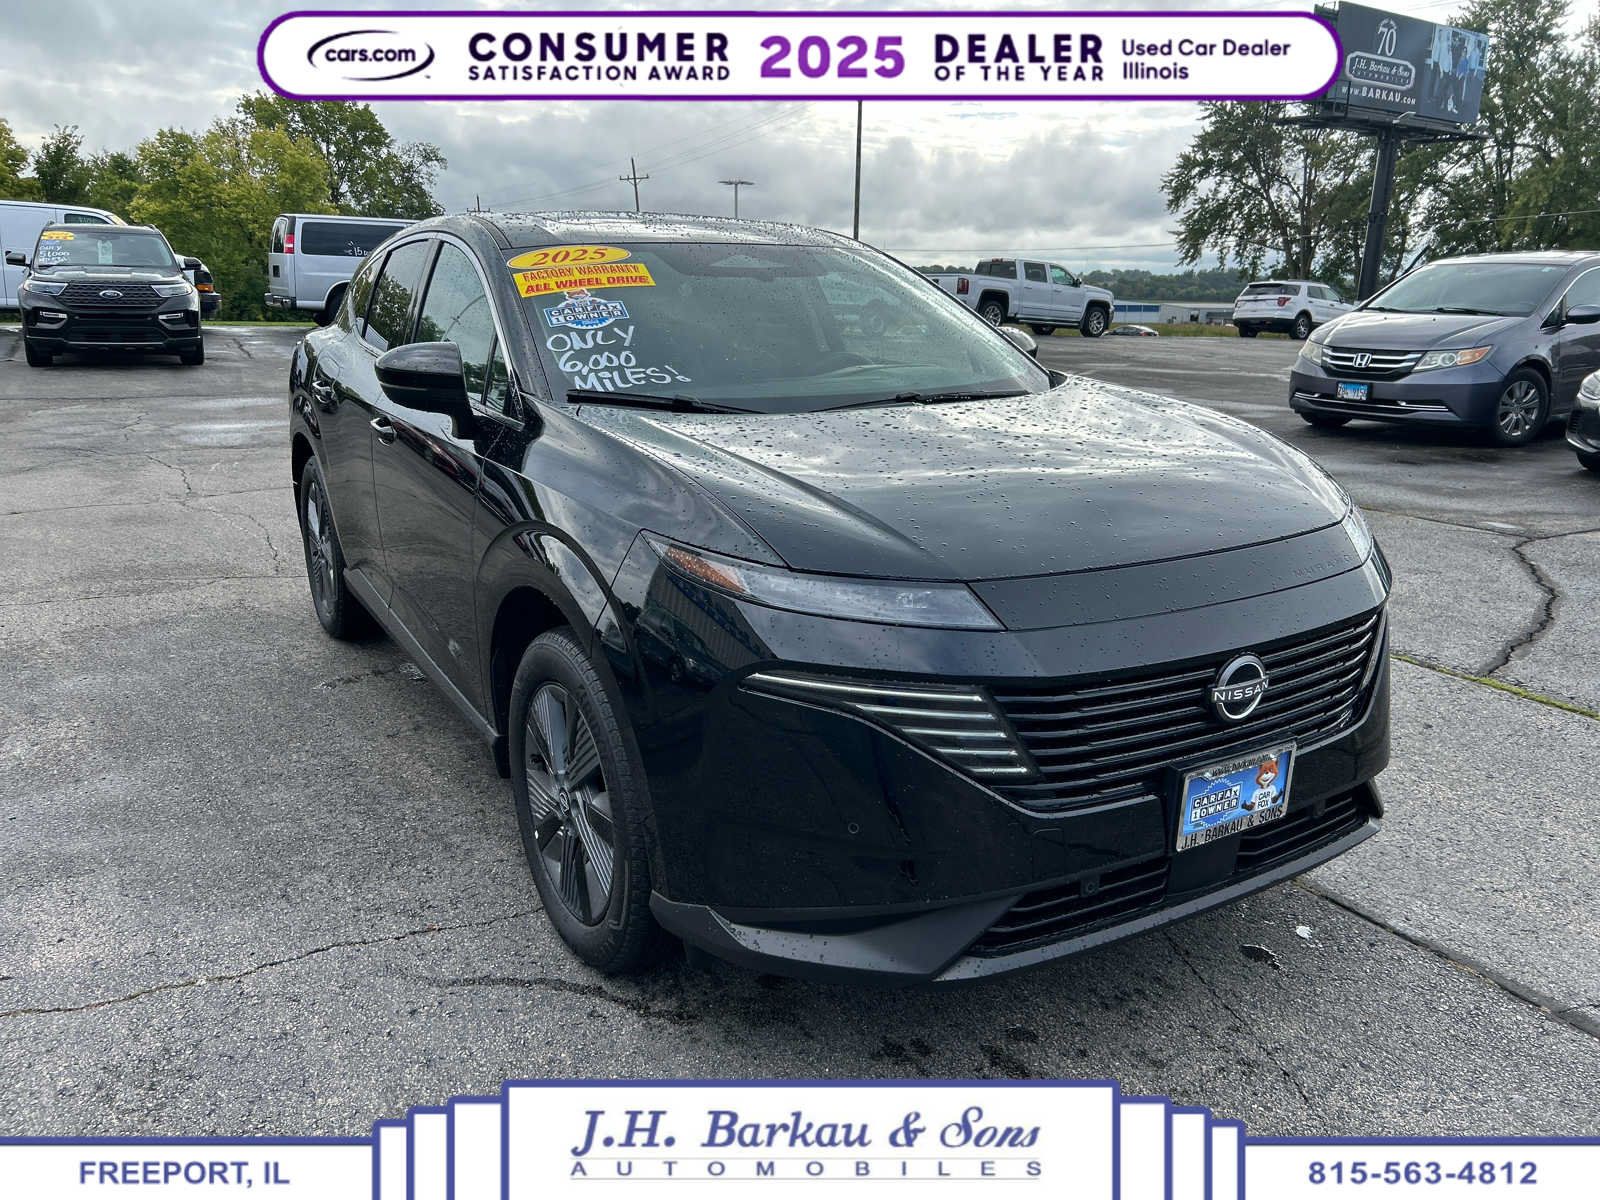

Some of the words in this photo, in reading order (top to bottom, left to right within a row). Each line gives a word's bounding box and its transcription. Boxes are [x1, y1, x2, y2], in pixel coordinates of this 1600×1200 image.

[1377, 27, 1397, 57] 70
[531, 248, 608, 266] 2025
[523, 267, 575, 282] FACTORY
[575, 264, 640, 276] WARRANTY
[525, 284, 554, 295] ALL
[555, 278, 606, 289] WHEEL
[606, 275, 650, 285] DRIVE
[551, 303, 619, 316] CARFAX
[566, 310, 622, 321] OWNER
[546, 325, 635, 351] ONLY
[558, 350, 637, 375] 6,000
[1214, 678, 1270, 701] NISSAN
[1194, 787, 1239, 808] CARFAX
[1257, 800, 1270, 809] FOX
[1258, 790, 1271, 800] CAR
[1201, 800, 1238, 818] OWNER
[1205, 817, 1243, 842] BARKAU
[1246, 814, 1255, 827] &
[1259, 805, 1283, 824] SONS
